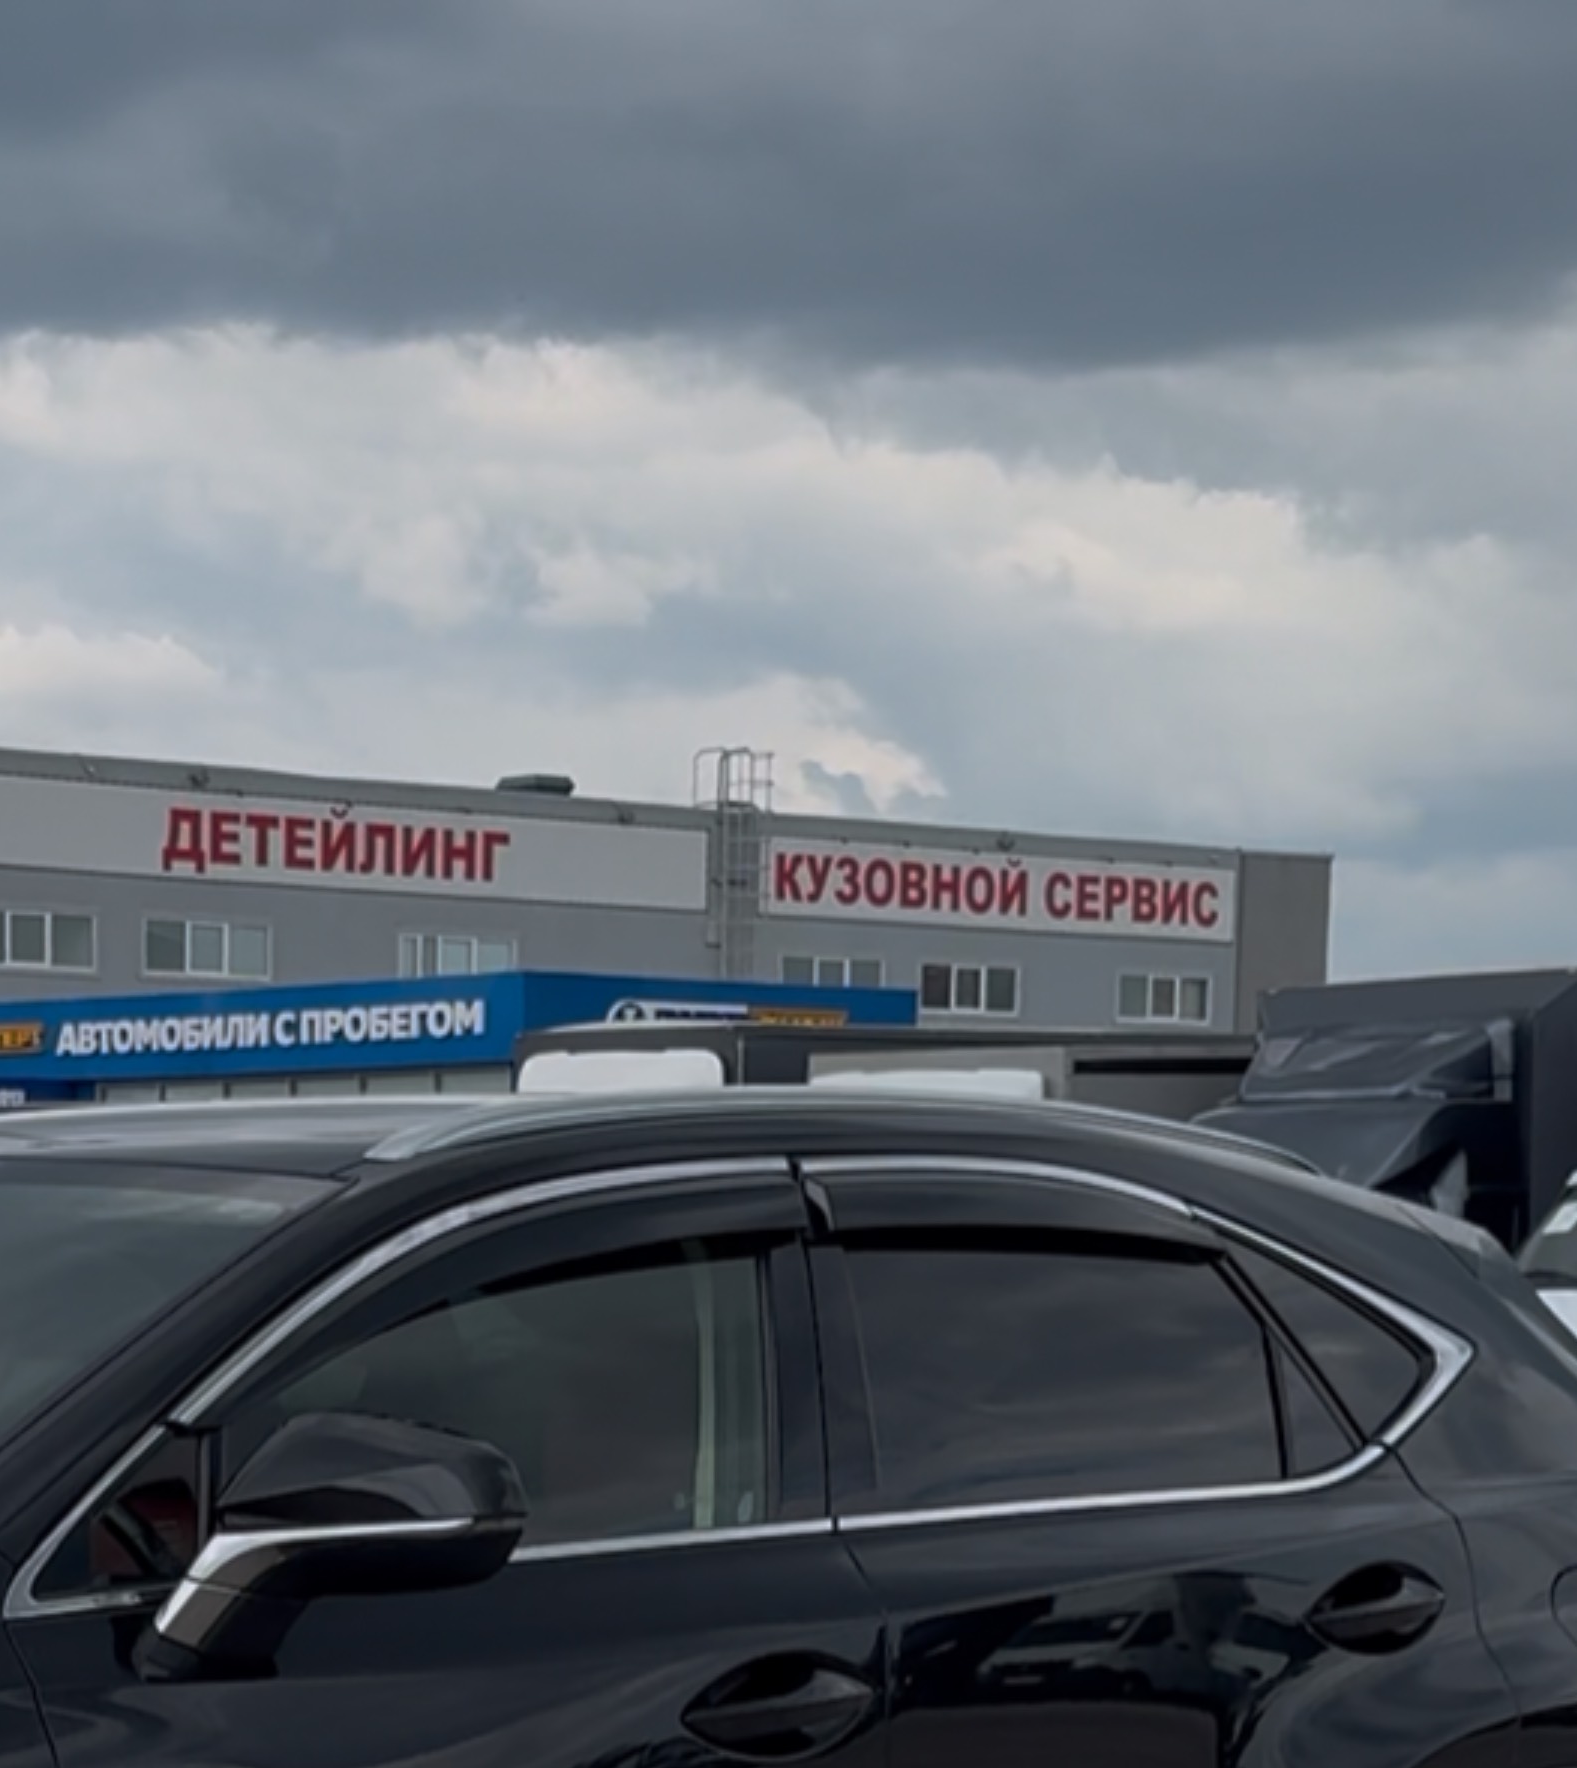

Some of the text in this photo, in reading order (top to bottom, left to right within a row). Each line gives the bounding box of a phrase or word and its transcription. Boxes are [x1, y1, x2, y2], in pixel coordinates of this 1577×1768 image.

[162, 804, 511, 882] ДЕТЕЙЛИНГ
[775, 851, 1219, 929] КУЗОВНОЙ СЕРВИС
[56, 1000, 486, 1056] АВТОМОБИЛИ С ПРОБЕГОМ
